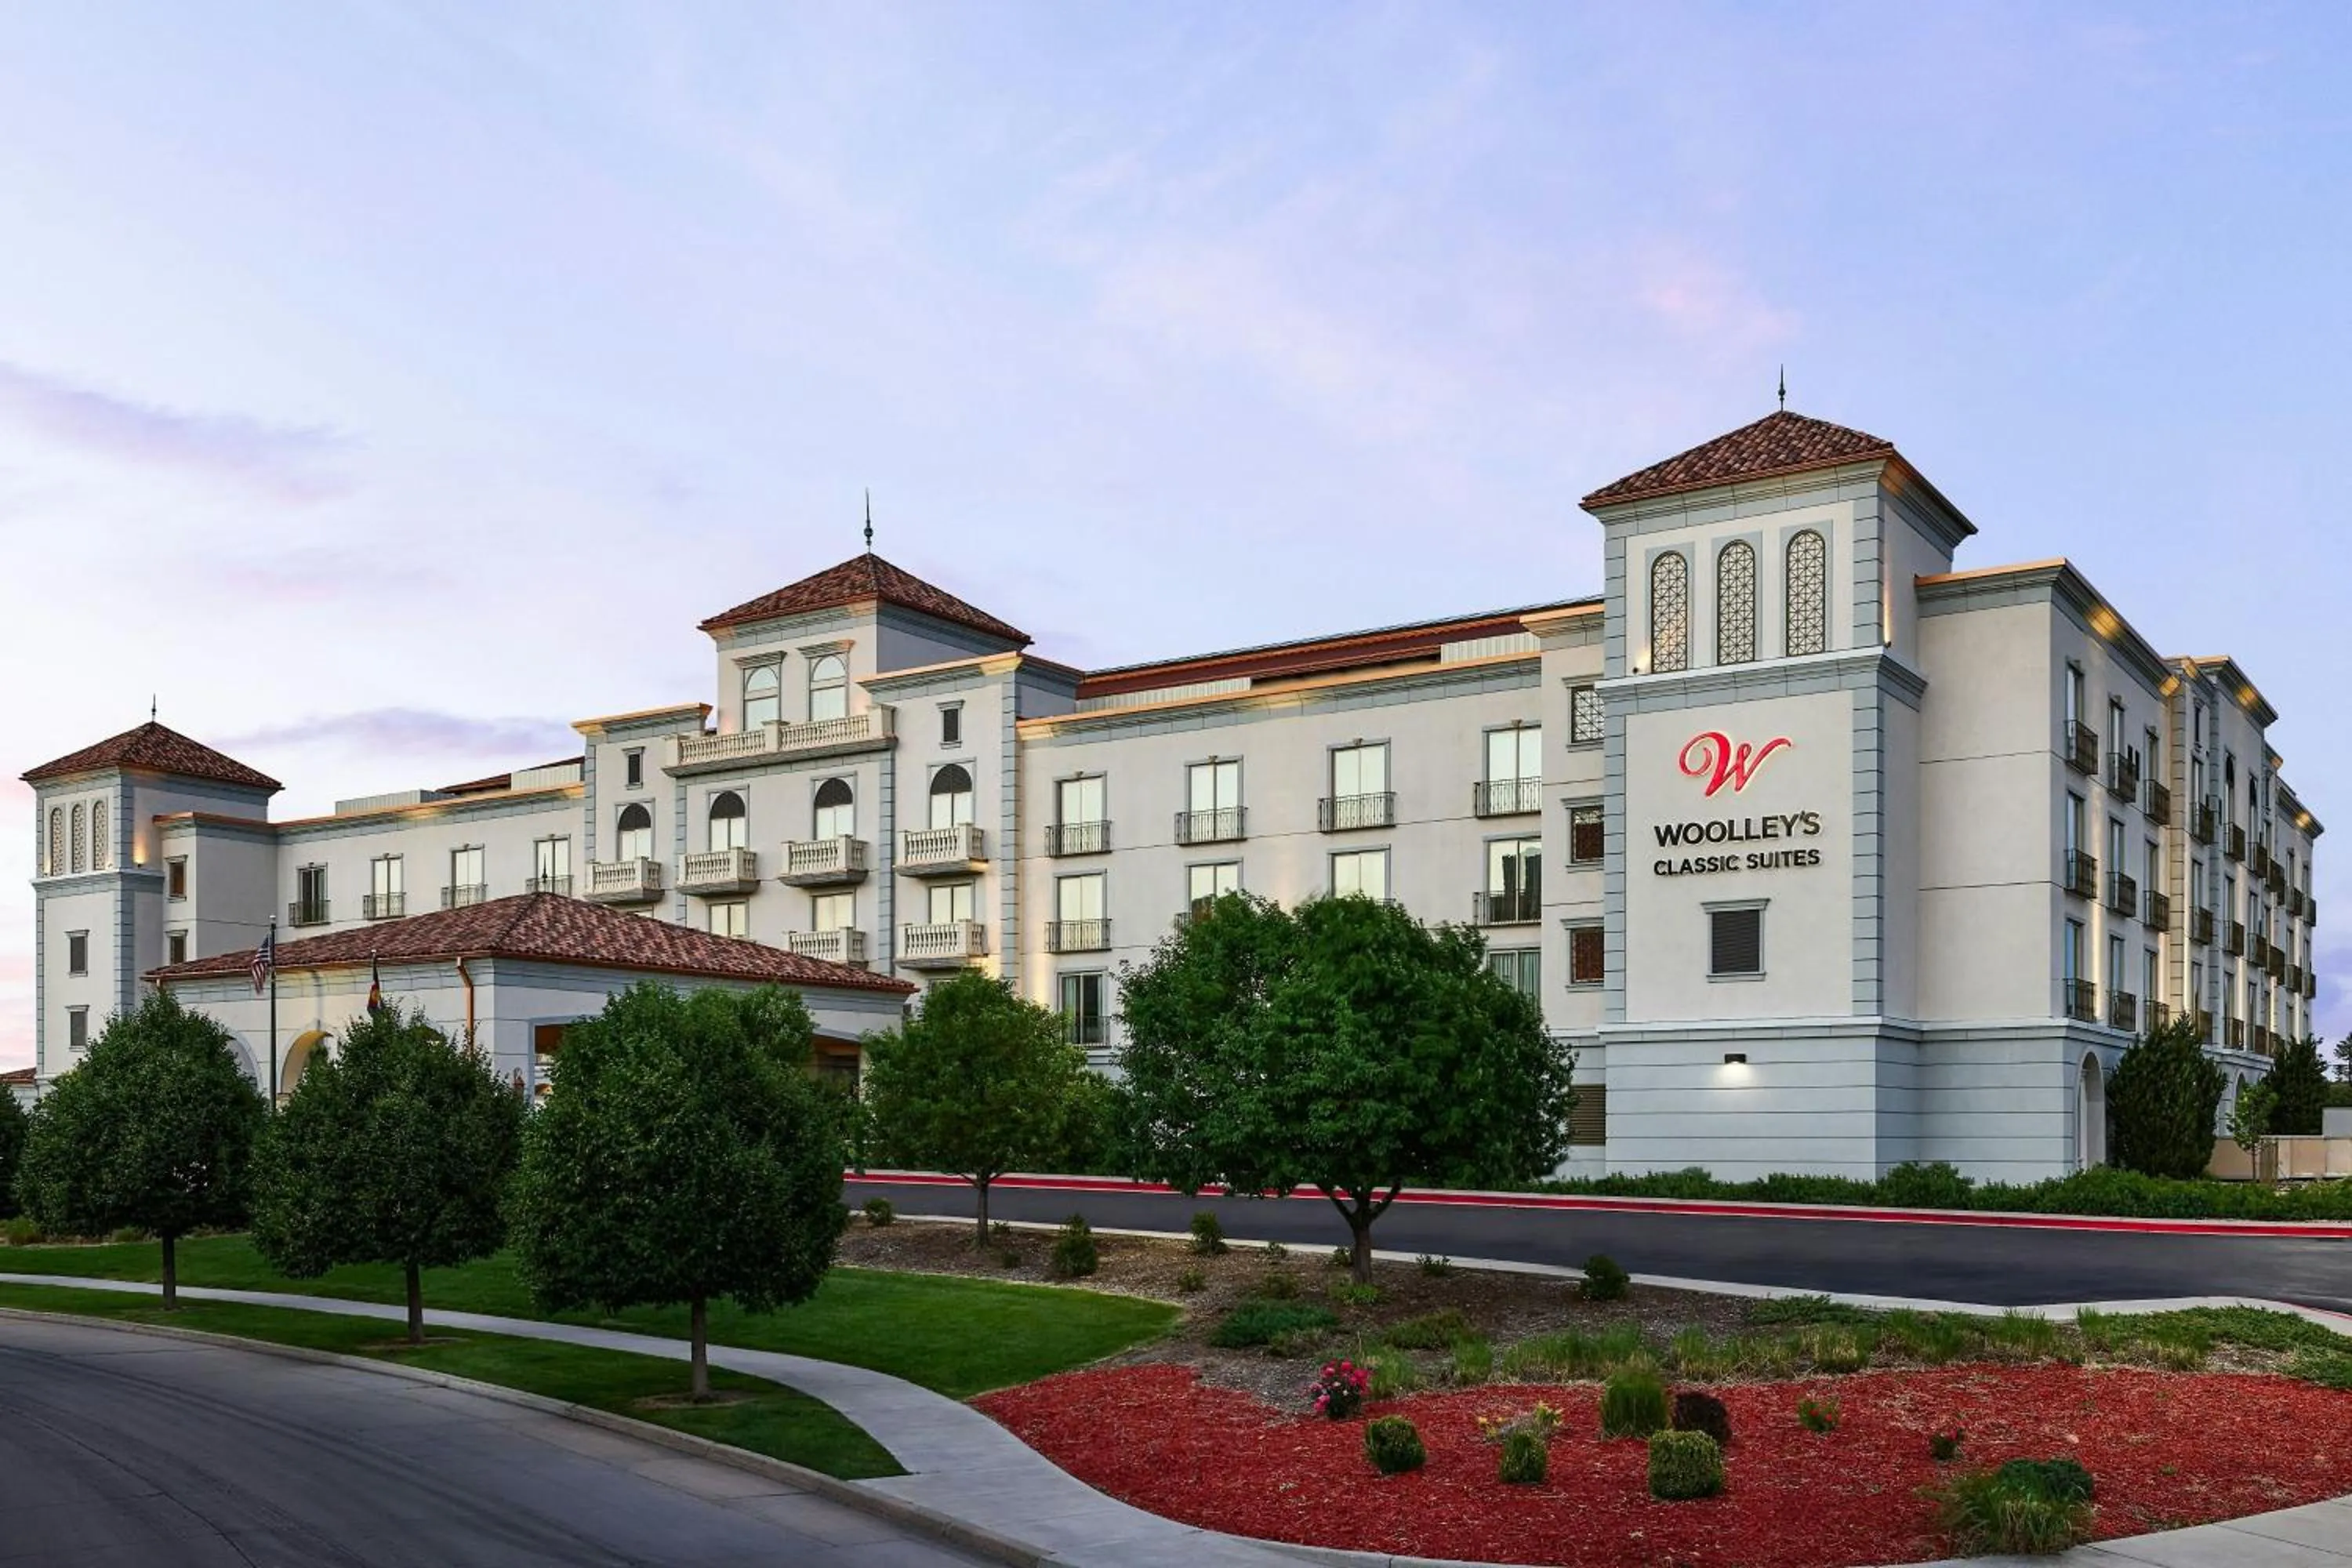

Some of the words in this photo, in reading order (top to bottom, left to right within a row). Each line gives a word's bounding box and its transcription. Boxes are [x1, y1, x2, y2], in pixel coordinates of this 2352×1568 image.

[1679, 731, 1791, 797] W
[1653, 810, 1820, 848] WOOLLEY'S
[1653, 855, 1740, 877] CLASSIC
[1746, 848, 1820, 869] SUITES
